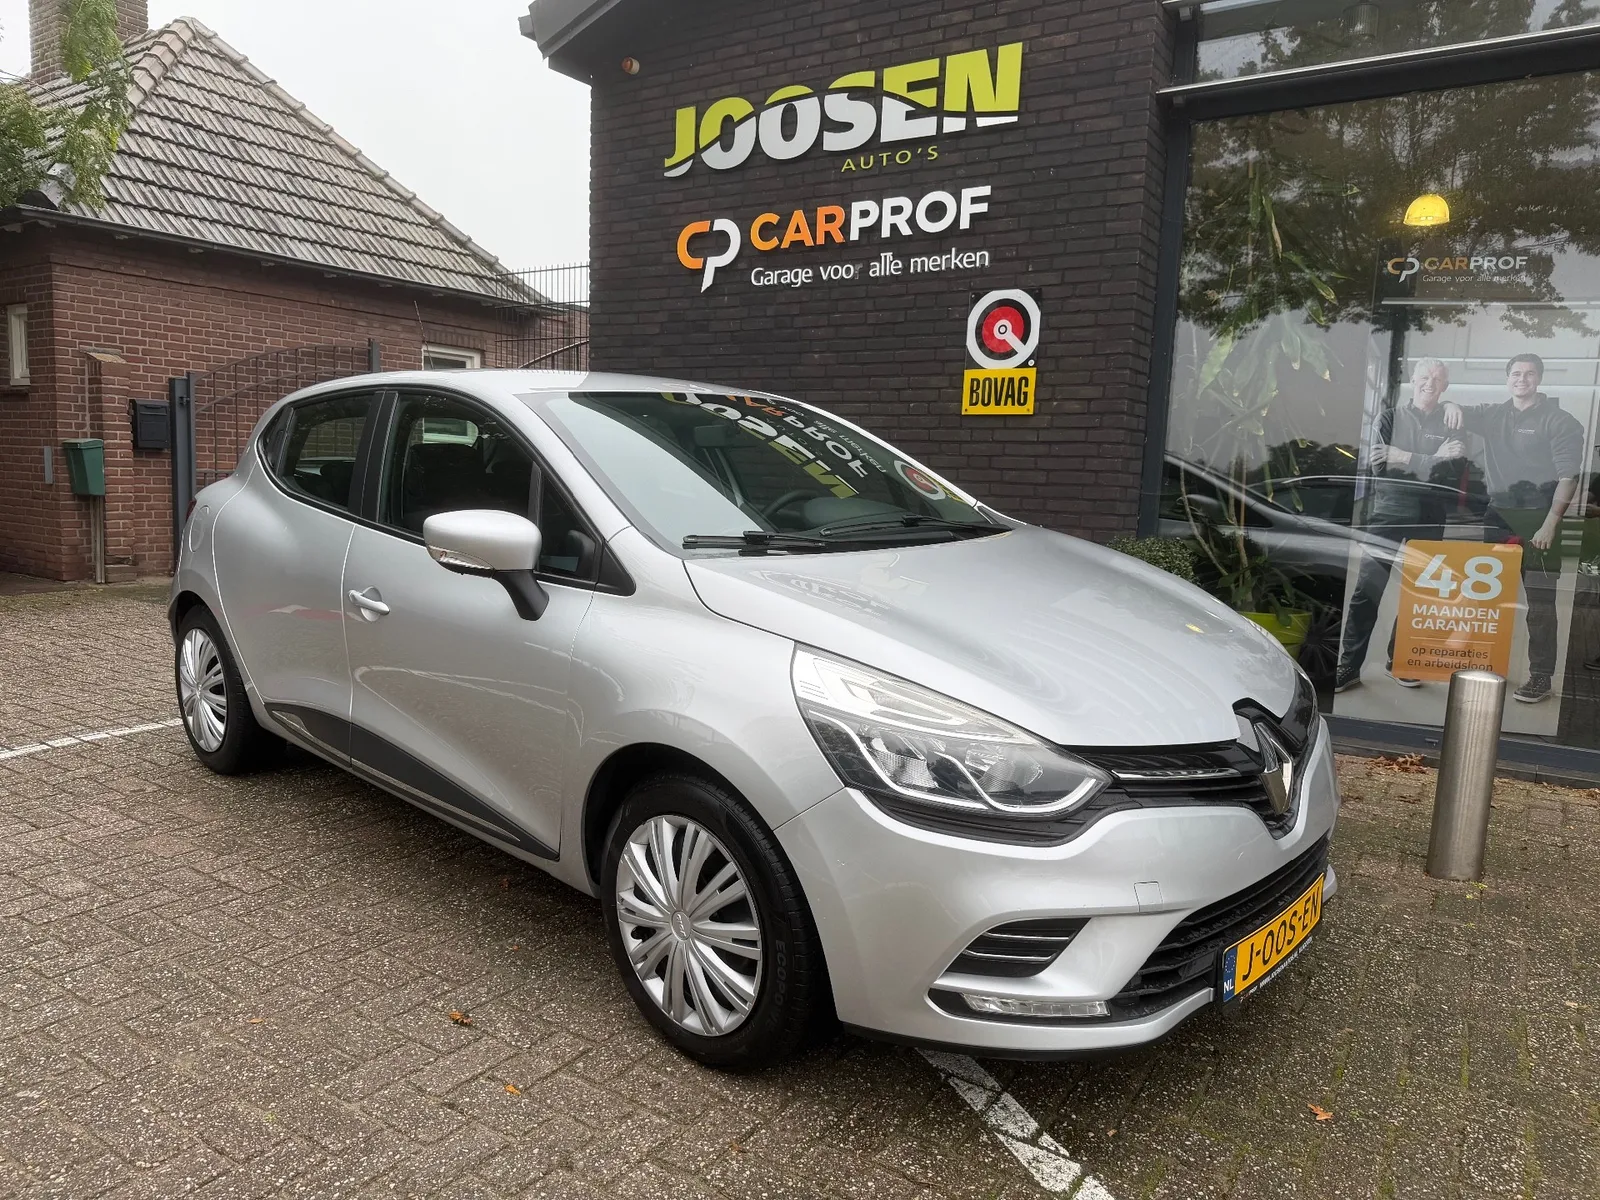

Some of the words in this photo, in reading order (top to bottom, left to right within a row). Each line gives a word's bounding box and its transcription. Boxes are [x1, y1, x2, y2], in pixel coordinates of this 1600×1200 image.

[663, 42, 1023, 178] JOOSEN
[840, 145, 939, 172] AUTO'S
[750, 185, 992, 251] CARPROF
[750, 267, 813, 288] Garage
[909, 247, 990, 274] merken
[1424, 256, 1528, 271] CARPROF
[1422, 274, 1452, 283] Garage
[1477, 274, 1491, 282] alle
[968, 376, 1029, 407] BOVAG
[1414, 554, 1504, 601] 48
[1412, 603, 1500, 620] MAANDEN
[1411, 617, 1498, 634] GARANTIE
[1411, 646, 1426, 655] op
[1429, 646, 1489, 659] reparaties
[1407, 658, 1421, 667] en
[1424, 657, 1493, 672] arbeidsloon
[1242, 886, 1320, 982] J-OOS-EN
[1223, 979, 1234, 993] NL
